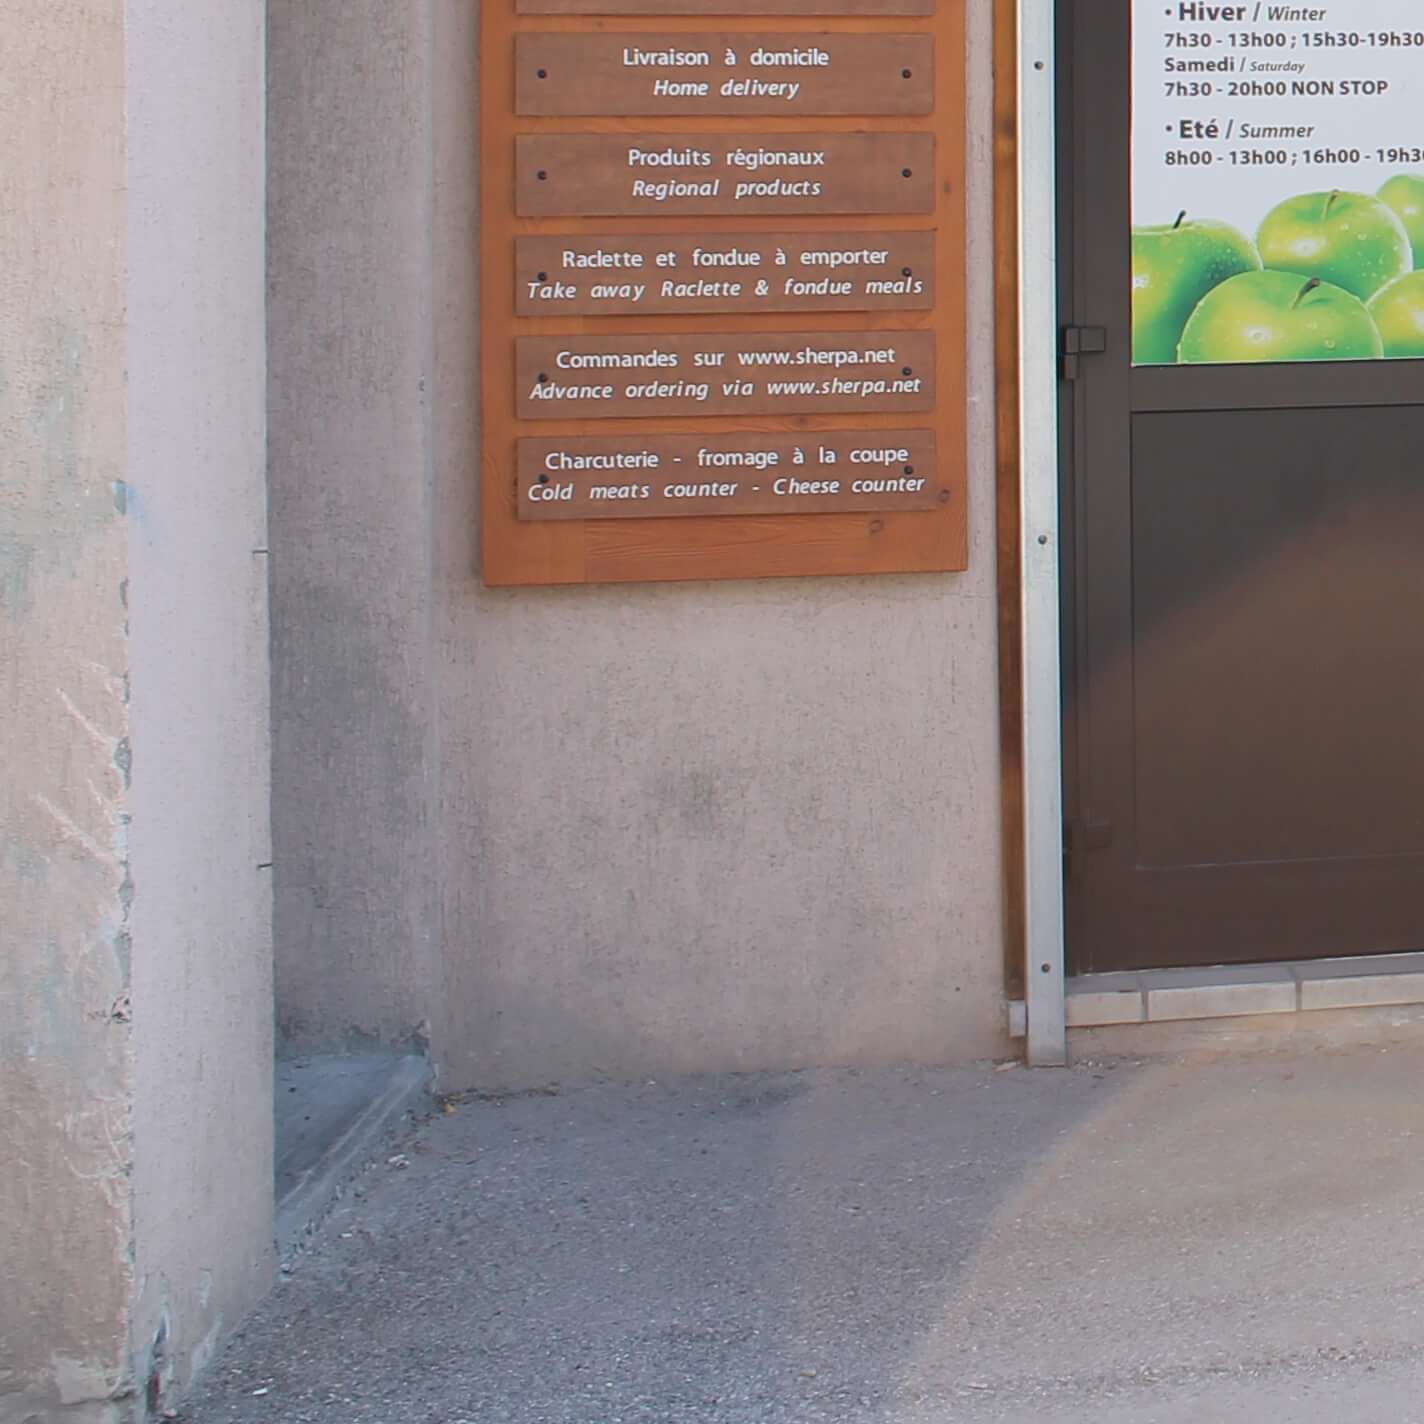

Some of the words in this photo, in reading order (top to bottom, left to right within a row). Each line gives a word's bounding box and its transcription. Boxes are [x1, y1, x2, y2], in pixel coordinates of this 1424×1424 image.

[1178, 1, 1246, 21] Hiver
[1267, 6, 1326, 21] Winter
[1164, 33, 1211, 47] 7h30
[1229, 33, 1285, 47] 13h00
[1302, 32, 1424, 47] 15h30-19h30
[623, 49, 708, 66] Livraison
[724, 48, 736, 66] à
[750, 50, 829, 67] domicile
[1164, 57, 1234, 72] Samedi
[1250, 61, 1305, 74] Saturday
[654, 80, 708, 96] Home
[721, 80, 799, 99] delivery
[1164, 82, 1212, 96] 7h30
[1228, 82, 1285, 96] 20h00
[1291, 81, 1334, 95] NON
[1340, 81, 1388, 95] STOP
[1179, 118, 1218, 138] Eté
[1240, 123, 1314, 138] Summer
[628, 149, 711, 166] Produits
[727, 148, 824, 168] régionaux
[1165, 151, 1212, 165] 8h00
[1229, 150, 1287, 164] 13h00
[1303, 149, 1360, 163] 16h00
[632, 180, 719, 199] Regional
[735, 179, 821, 200] products
[563, 251, 642, 268] Raclette
[656, 252, 676, 268] et
[692, 249, 760, 267] fondue
[775, 248, 786, 266] à
[800, 249, 888, 268] emporter
[528, 282, 577, 299] Take
[591, 283, 644, 301] away
[661, 280, 741, 297] Raclette
[755, 280, 768, 296] &
[784, 279, 852, 296] fondue
[866, 277, 923, 294] meals
[556, 351, 678, 369] Commandes
[694, 351, 724, 367] sur
[738, 348, 895, 367] www.sherpa.net
[530, 382, 612, 400] Advance
[626, 381, 708, 401] ordering
[723, 380, 753, 396] via
[767, 379, 920, 397] www.sherpa.net
[546, 451, 658, 470] Charcuterie
[697, 449, 778, 468] fromage
[793, 448, 803, 464] à
[819, 447, 835, 464] la
[850, 448, 908, 466] coupe
[528, 484, 572, 501] Cold
[590, 483, 649, 500] meats
[663, 482, 737, 498] counter
[774, 478, 839, 495] Cheese
[851, 477, 924, 493] counter
